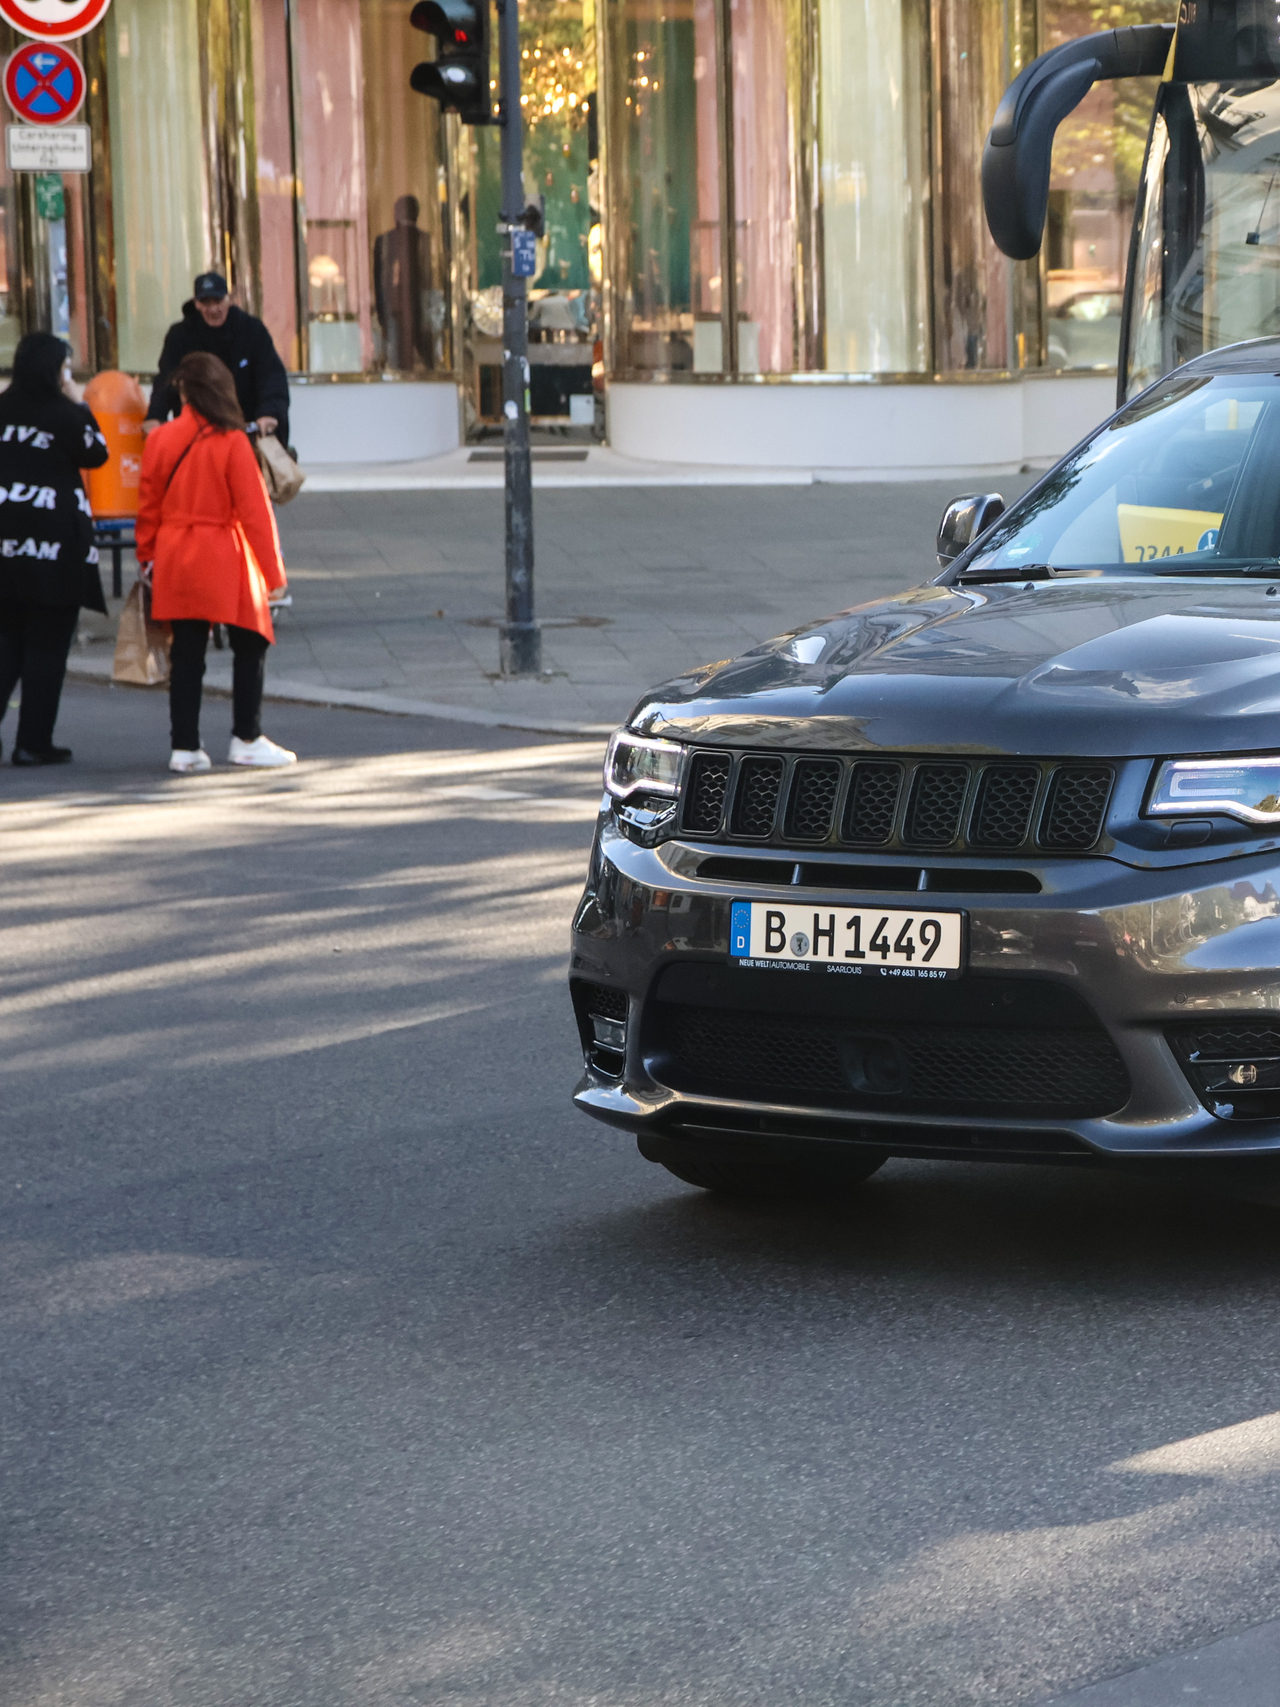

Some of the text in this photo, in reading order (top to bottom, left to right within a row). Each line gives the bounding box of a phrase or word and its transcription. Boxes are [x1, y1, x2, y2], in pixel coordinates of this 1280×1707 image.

[18, 130, 77, 142] Carsharing
[0, 424, 55, 449] IVE
[0, 537, 61, 561] EAM
[736, 935, 745, 949] D
[765, 910, 786, 953] B
[739, 959, 754, 967] NEUE
[755, 960, 769, 968] WELT
[827, 965, 862, 974] SAARLOUIS
[889, 968, 900, 976] +49
[902, 969, 915, 977] 6831
[929, 970, 938, 978] 85
[938, 971, 947, 979] 97
